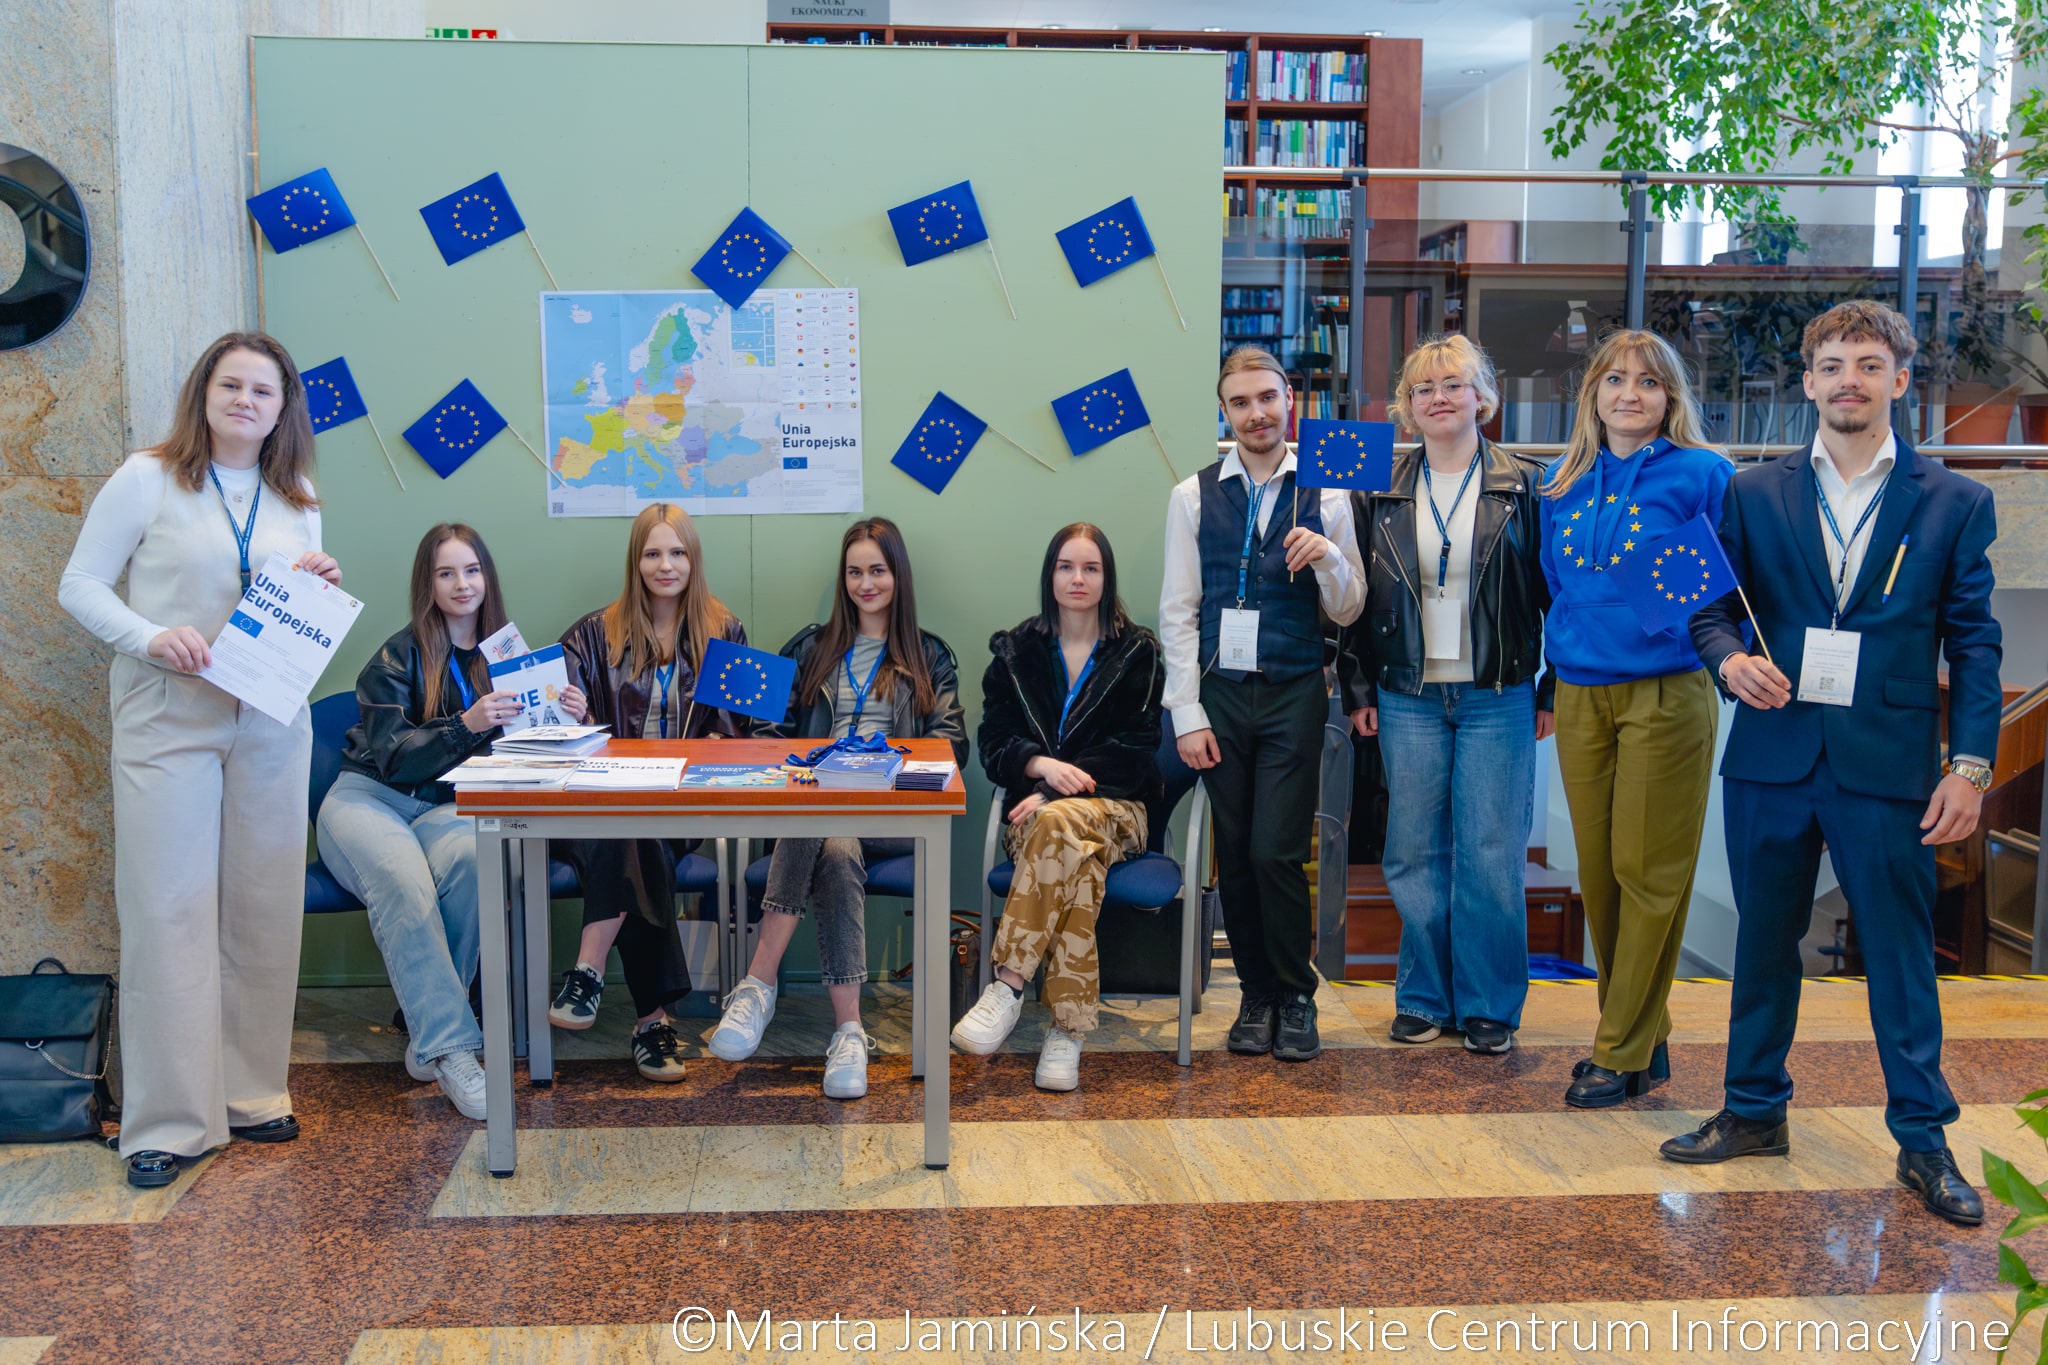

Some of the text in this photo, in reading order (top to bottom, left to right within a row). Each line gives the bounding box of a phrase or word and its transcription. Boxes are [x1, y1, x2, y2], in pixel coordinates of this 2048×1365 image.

[791, 7, 867, 17] EKONOMICZNE
[782, 423, 811, 435] Unia
[783, 436, 856, 450] Europejska
[254, 572, 290, 603] Unia
[244, 588, 332, 649] Europejska
